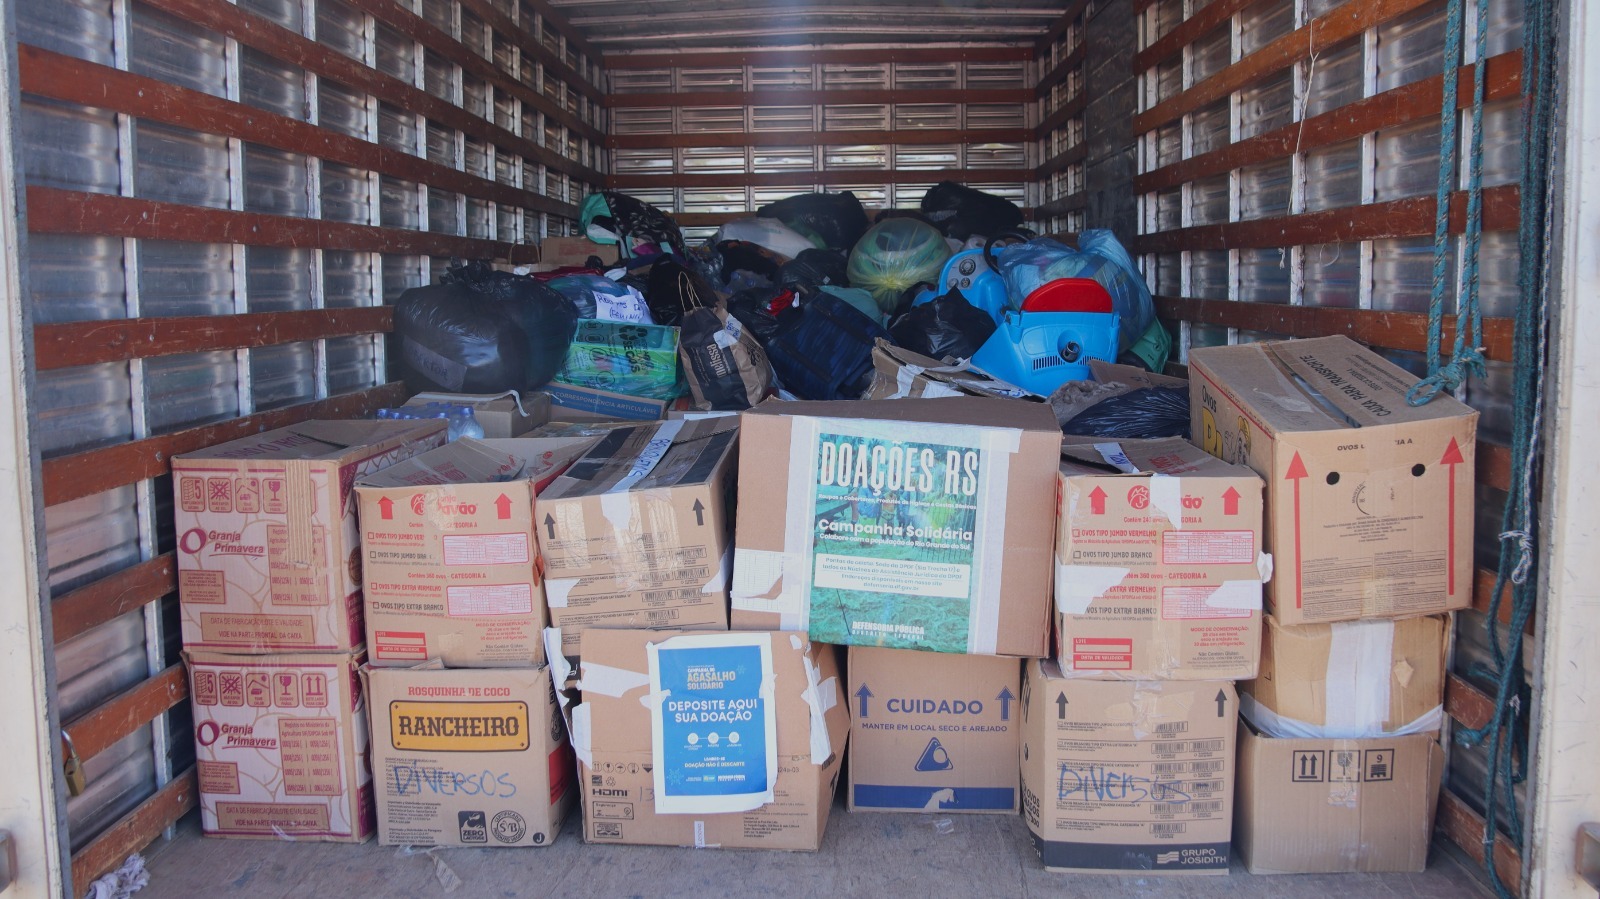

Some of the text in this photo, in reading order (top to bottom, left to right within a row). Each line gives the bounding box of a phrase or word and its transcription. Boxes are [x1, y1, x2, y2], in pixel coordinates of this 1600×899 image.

[706, 343, 727, 378] melissa
[1299, 354, 1348, 386] TRANSPORTE
[1341, 384, 1368, 400] PARA
[555, 391, 658, 414] CORRESPONDÊNCIA ARTICULÁVEL
[1361, 399, 1392, 417] CAIXA
[820, 440, 978, 496] DOAÇÕES RS
[818, 493, 839, 501] Roupas
[844, 495, 876, 504] Cobertores,
[818, 518, 973, 541] Campanha Solidária
[1081, 529, 1096, 537] OVOS
[1109, 530, 1128, 538] JUMBO
[1128, 530, 1157, 538] VERMELHO
[208, 530, 241, 542] Granja
[214, 543, 265, 554] Primavera
[870, 537, 905, 547] população
[926, 541, 951, 549] Grande
[400, 552, 416, 560] JUMBO
[1111, 551, 1130, 559] JUMBO
[1130, 551, 1153, 559] BRANCO
[1168, 572, 1201, 580] CATEGORIA
[418, 584, 442, 592] VERMELHO
[394, 602, 406, 610] TIPO
[406, 603, 422, 611] EXTRA
[1098, 606, 1158, 615] TIPO EXTRA BRANCO
[851, 620, 925, 635] DEFENSORIA PÚBLICA
[218, 630, 230, 638] VIDE
[687, 671, 736, 682] AGASALHO
[687, 681, 724, 690] SOLIDÁRIO
[407, 685, 511, 698] ROSQUINHA DE COCO
[668, 698, 757, 711] DEPOSITE AQUI
[886, 698, 984, 715] CUIDADO
[675, 708, 753, 724] SUA DOAÇÃO
[221, 723, 254, 735] Granja
[398, 715, 520, 738] RANCHEIRO
[862, 722, 895, 730] MANTER
[896, 723, 909, 731] EM
[910, 724, 937, 732] LOCAL
[227, 735, 277, 747] Primavera
[684, 761, 706, 769] DOAÇÃO
[1376, 755, 1383, 764] 9
[393, 760, 517, 799] DIVERSOS
[592, 788, 628, 797] HDMI
[1181, 848, 1217, 856] GRUPO
[1180, 856, 1227, 865] JOSIDITH
